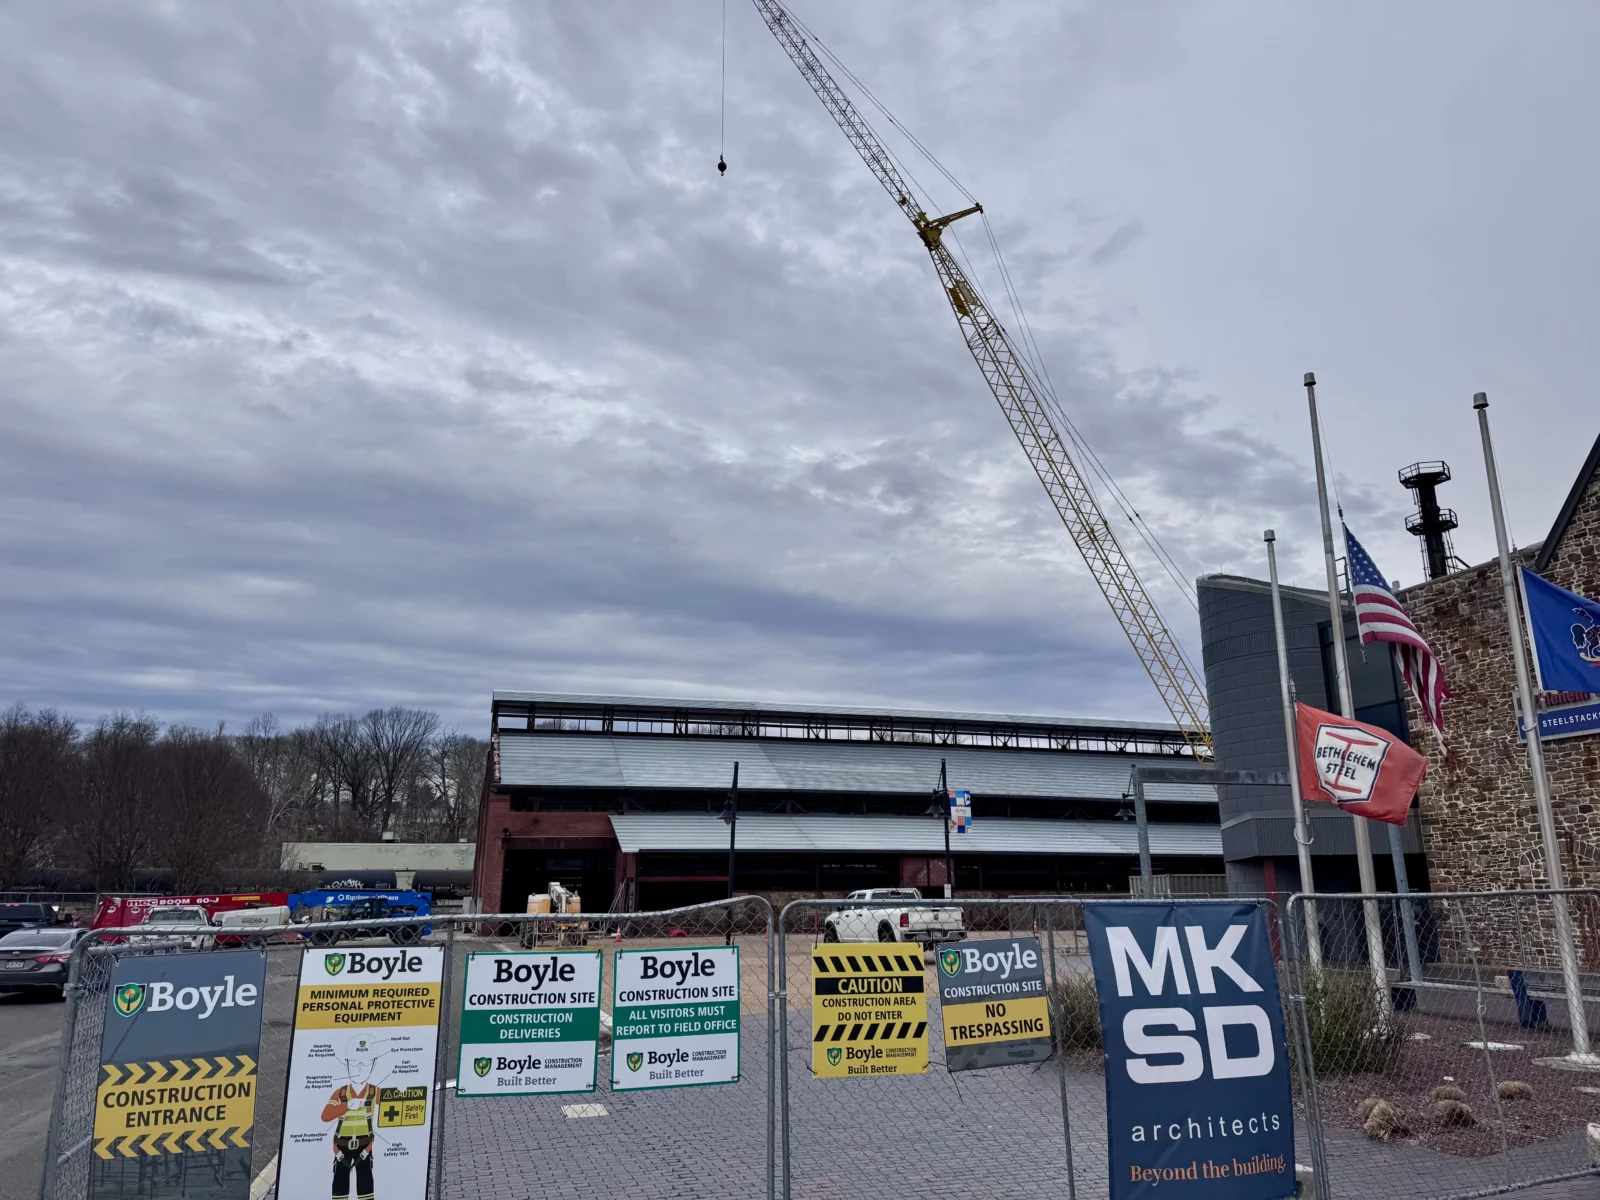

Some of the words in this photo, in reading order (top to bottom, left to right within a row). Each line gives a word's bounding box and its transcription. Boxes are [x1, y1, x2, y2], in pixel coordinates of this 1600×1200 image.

[1316, 746, 1377, 771] BETHLEHEM
[1325, 762, 1356, 780] STEEL
[346, 950, 422, 980] Boyle
[640, 952, 716, 986] Boyle
[962, 943, 1037, 979] Boyle
[1105, 924, 1264, 997] MK
[492, 956, 575, 990] Boyle
[310, 988, 369, 1000] MINIMUM
[372, 987, 430, 998] REQUIRED
[619, 987, 708, 1002] CONSTRUCTION
[712, 986, 735, 998] SITE
[838, 978, 903, 994] CAUTION
[944, 982, 1020, 998] CONSTRUCTION
[1022, 980, 1042, 992] SITE
[147, 975, 258, 1019] Boyle
[302, 1000, 363, 1012] PERSONAL
[367, 999, 435, 1010] PROTECTIVE
[468, 992, 566, 1006] CONSTRUCTION
[570, 992, 595, 1004] SITE
[822, 997, 890, 1008] CONSTRUCTION
[893, 997, 917, 1006] AREA
[334, 1012, 402, 1024] EQUIPMENT
[490, 1013, 573, 1024] CONSTRUCTION
[629, 1010, 647, 1020] ALL
[650, 1008, 695, 1019] VISITORS
[698, 1006, 725, 1017] MUST
[838, 1012, 851, 1021] DO
[854, 1011, 872, 1020] NOT
[875, 1011, 902, 1020] ENTER
[985, 1003, 1006, 1018] NO
[500, 1028, 560, 1040] DELIVERIES
[616, 1024, 655, 1036] REPORT
[658, 1024, 672, 1033] TO
[674, 1022, 701, 1033] FIELD
[704, 1020, 737, 1031] OFFICE
[950, 1018, 1044, 1040] TRESPASSING
[1122, 1004, 1275, 1084] SD
[647, 1049, 689, 1067] Boyle
[846, 1045, 883, 1062] Boyle
[496, 1055, 541, 1074] Boyle
[848, 1065, 868, 1074] Built
[871, 1065, 897, 1073] Better
[497, 1076, 523, 1086] Built
[524, 1076, 557, 1085] Better
[649, 1070, 673, 1080] Built
[674, 1069, 704, 1079] Better
[103, 1081, 251, 1108] CONSTRUCTION
[393, 1089, 423, 1098] CAUTION
[126, 1104, 226, 1128] ENTRANCE
[1132, 1112, 1280, 1142] architects
[1130, 1161, 1198, 1186] Beyond
[1202, 1158, 1229, 1179] the
[1232, 1153, 1286, 1176] building.
